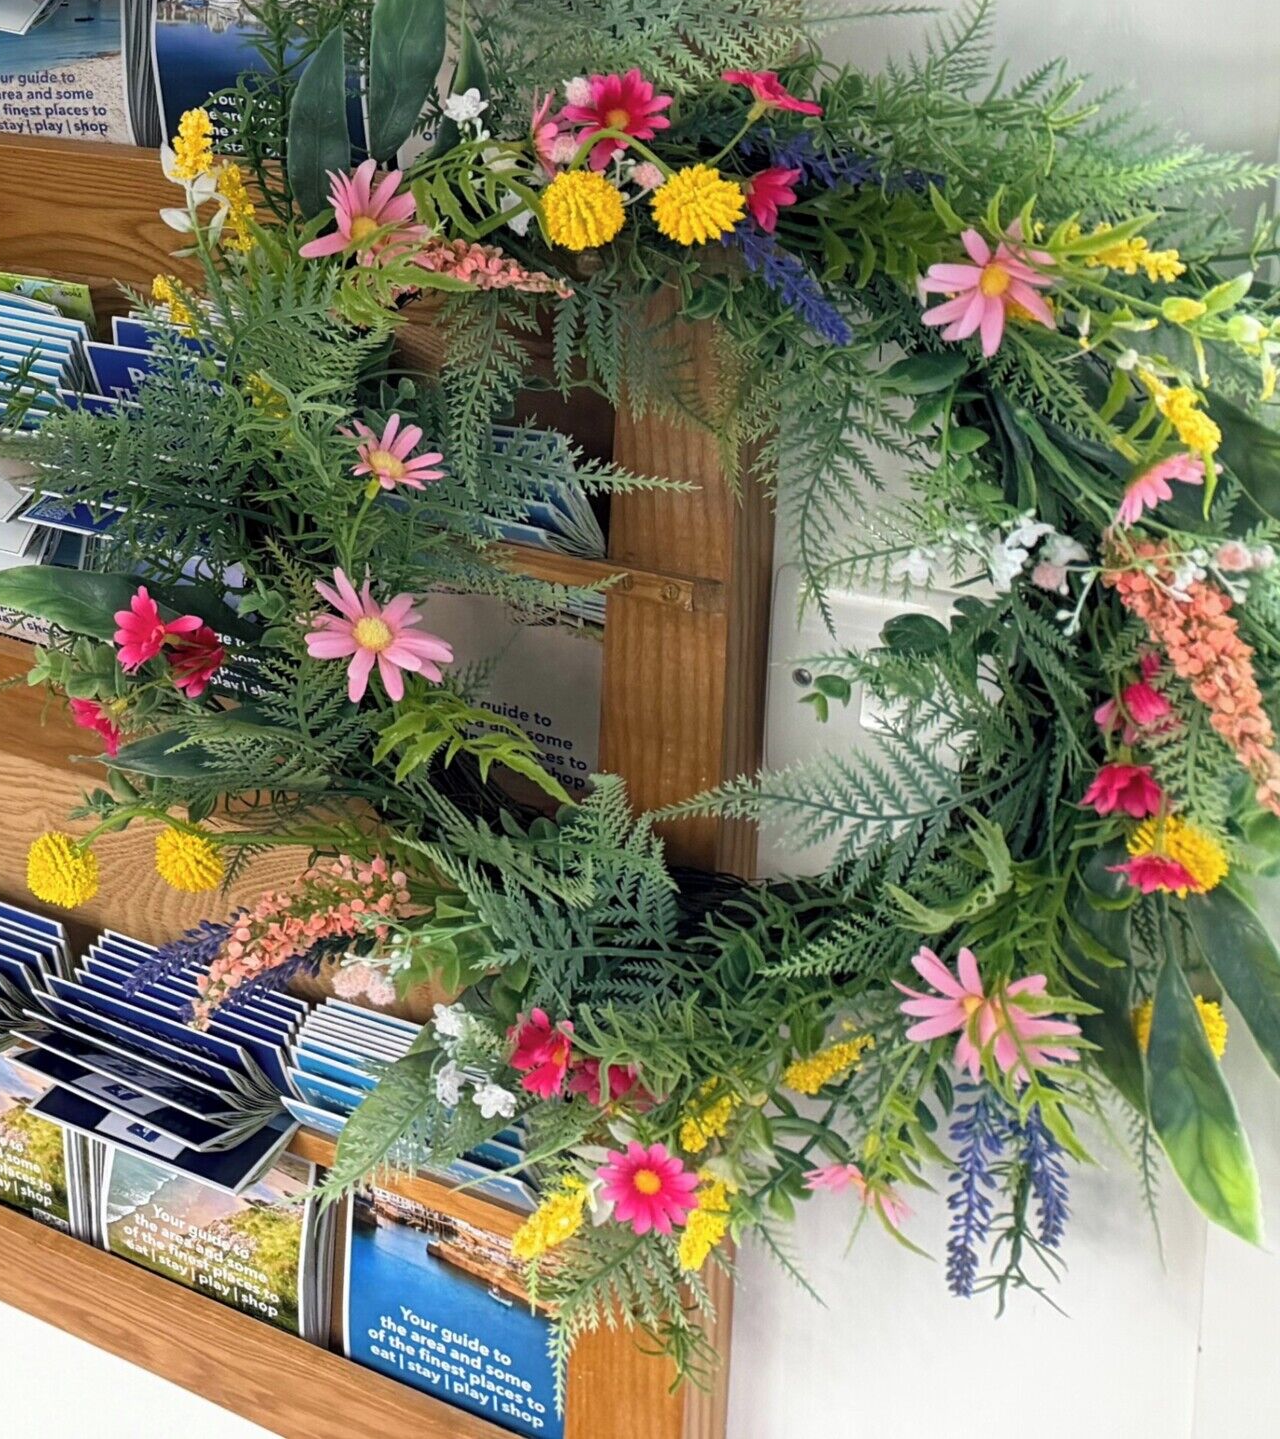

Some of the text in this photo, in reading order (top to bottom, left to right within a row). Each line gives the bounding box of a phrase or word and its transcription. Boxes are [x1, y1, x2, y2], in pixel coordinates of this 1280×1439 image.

[18, 71, 57, 86] guide
[61, 72, 75, 83] to
[26, 88, 52, 100] and
[55, 89, 94, 100] some
[2, 103, 41, 117] finest
[44, 104, 88, 119] places
[91, 105, 107, 117] to
[34, 120, 63, 134] play
[73, 120, 108, 137] shop
[534, 712, 552, 727] to
[526, 730, 573, 750] some
[570, 756, 587, 771] to
[399, 1306, 512, 1366] Your guide to
[380, 1315, 531, 1393] the area and some
[368, 1328, 546, 1414] of the finest places to
[370, 1344, 544, 1429] eat stay play shop
